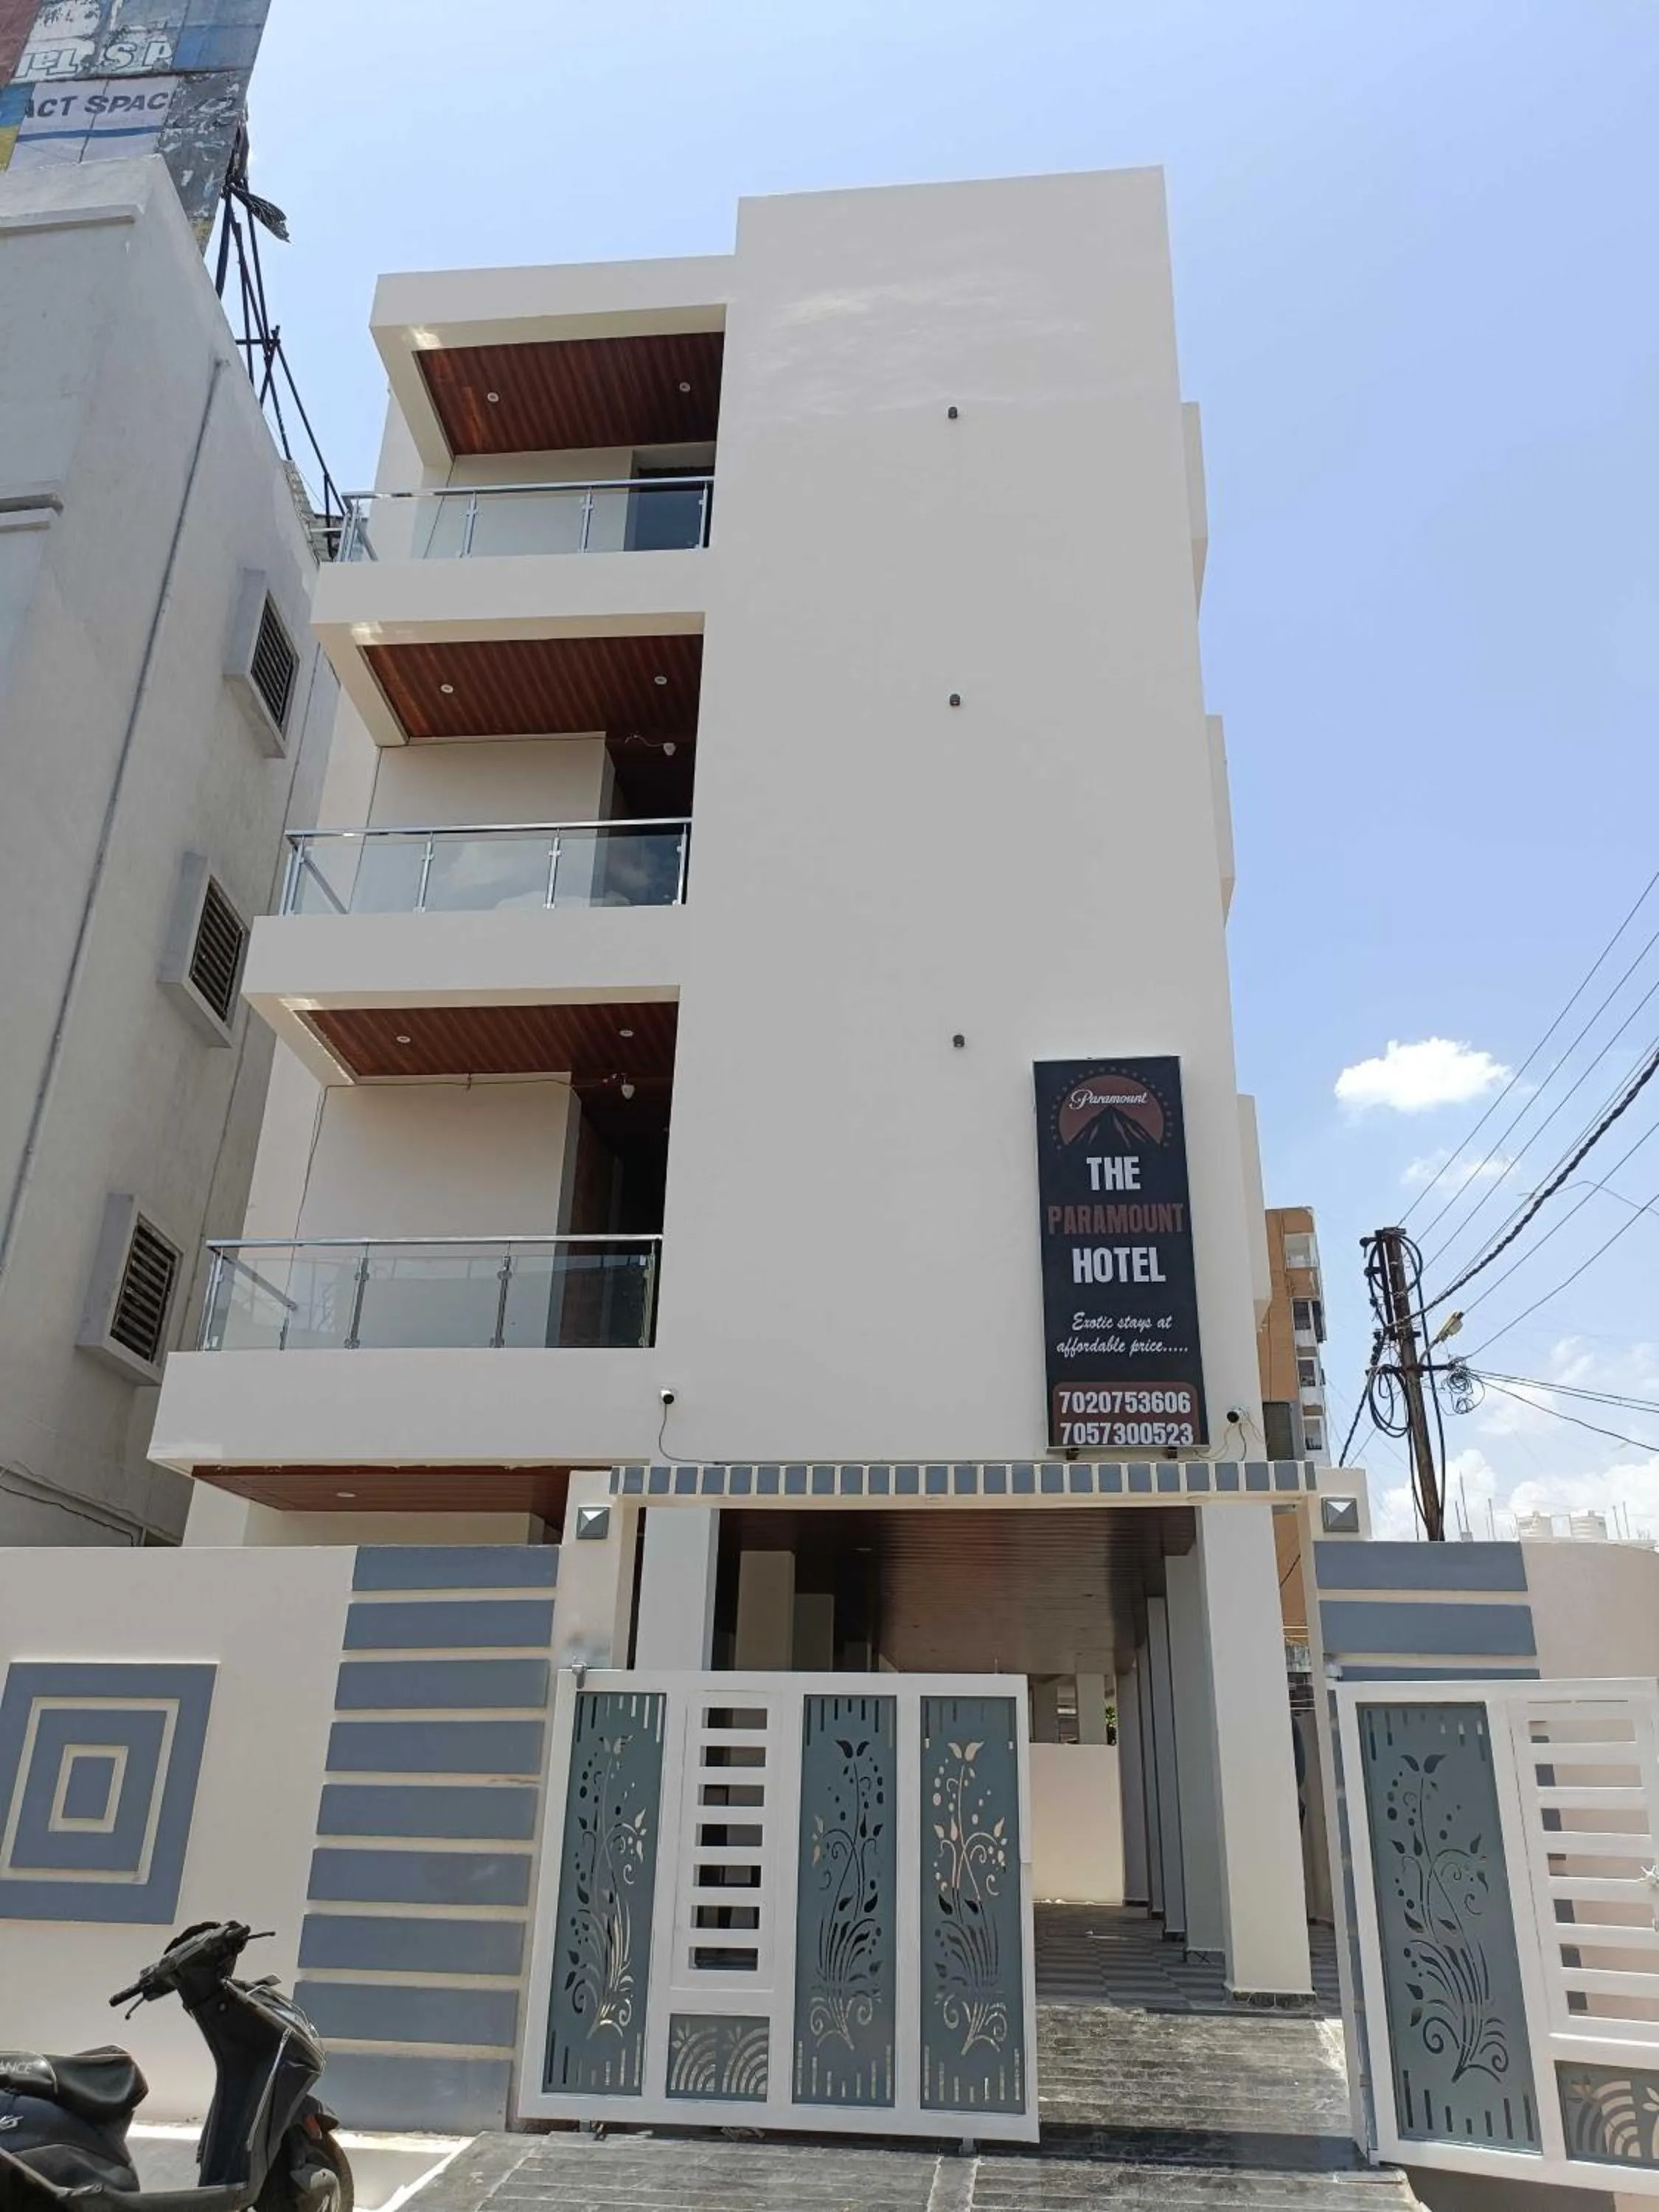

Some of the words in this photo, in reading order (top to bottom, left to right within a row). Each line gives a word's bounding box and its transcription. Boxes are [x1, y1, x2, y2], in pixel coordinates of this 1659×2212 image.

[1069, 1089, 1147, 1110] Paramount
[1086, 1156, 1141, 1191] THE
[1047, 1203, 1183, 1235] PARAMOUNT
[1071, 1247, 1166, 1283] HOTEL
[1072, 1312, 1114, 1331] Exotic
[1117, 1315, 1152, 1333] stays
[1157, 1315, 1172, 1329] at
[1056, 1335, 1126, 1357] affordable
[1059, 1391, 1191, 1413] 7020753606
[1060, 1422, 1194, 1445] 7057300523
